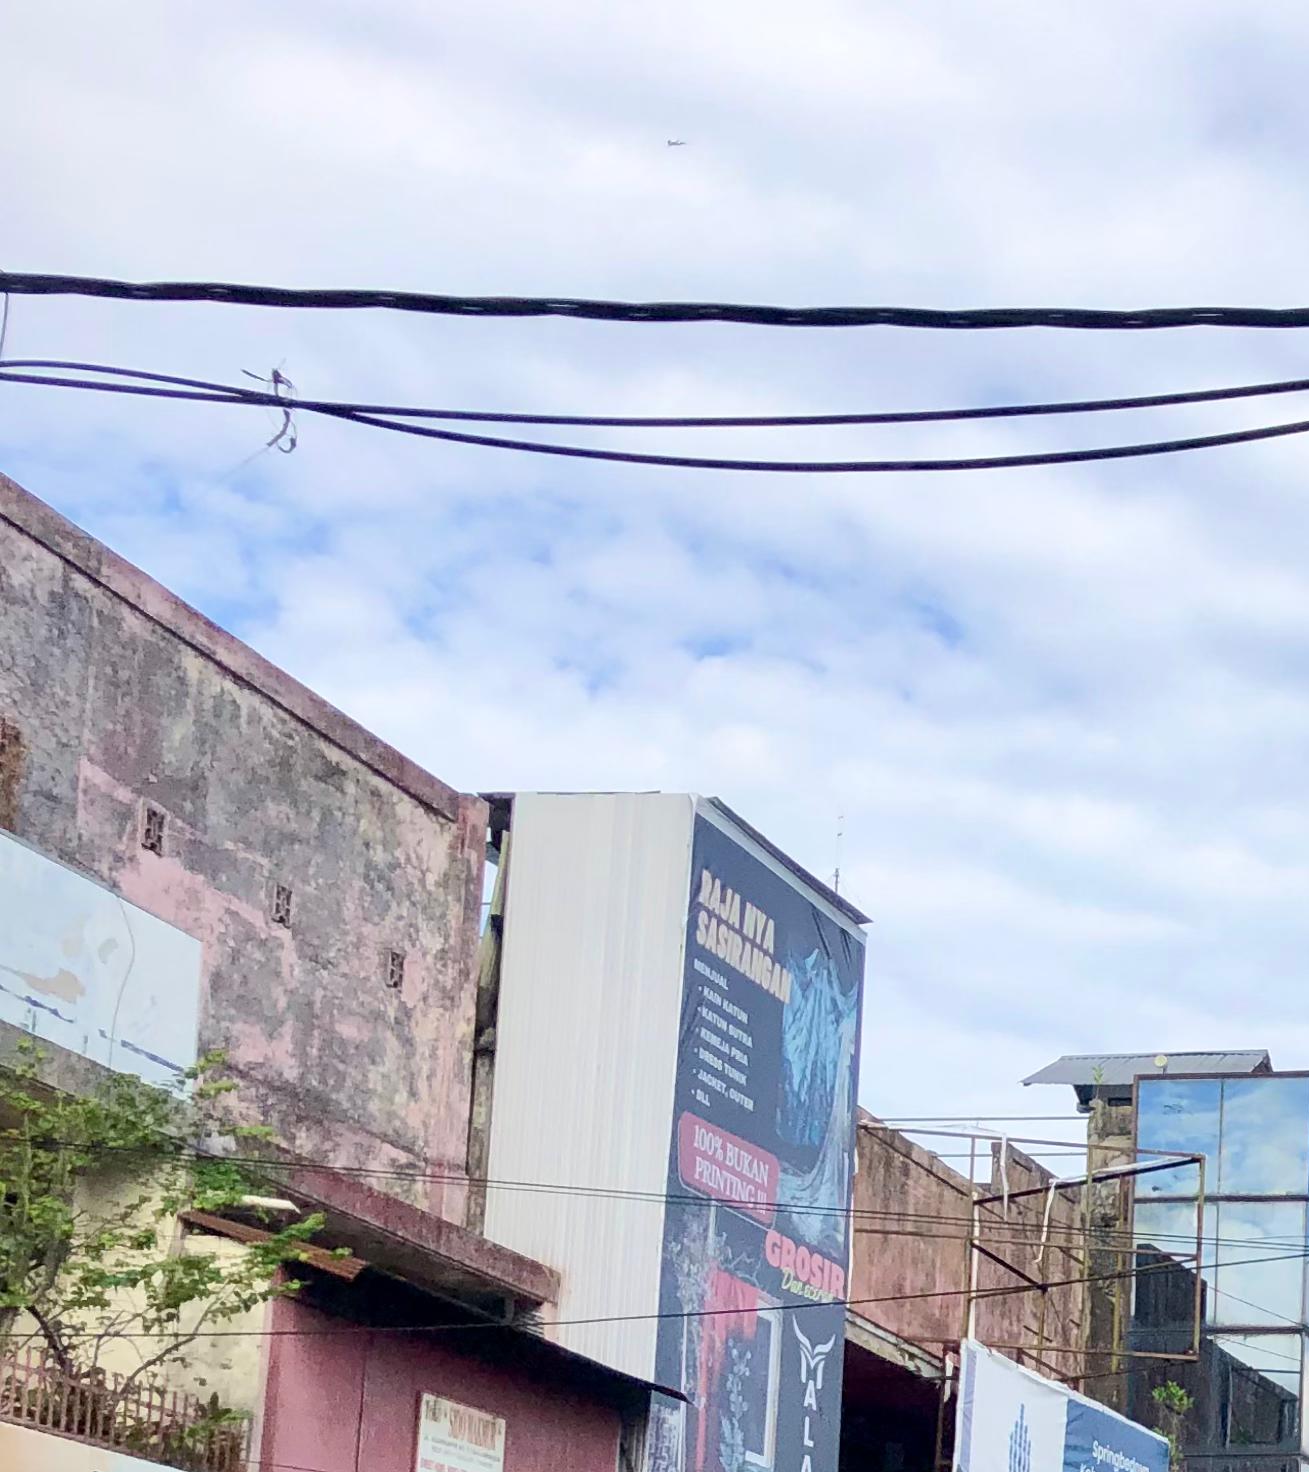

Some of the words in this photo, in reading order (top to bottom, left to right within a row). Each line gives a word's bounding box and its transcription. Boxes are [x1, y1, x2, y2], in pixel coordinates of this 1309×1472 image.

[698, 869, 741, 929] RAJA
[696, 910, 792, 1004] SASIRANGAN
[693, 1124, 724, 1162] 100%
[725, 1142, 769, 1187] BUKAN
[694, 1156, 755, 1210] PRINTING
[765, 1229, 847, 1301] GROSIR
